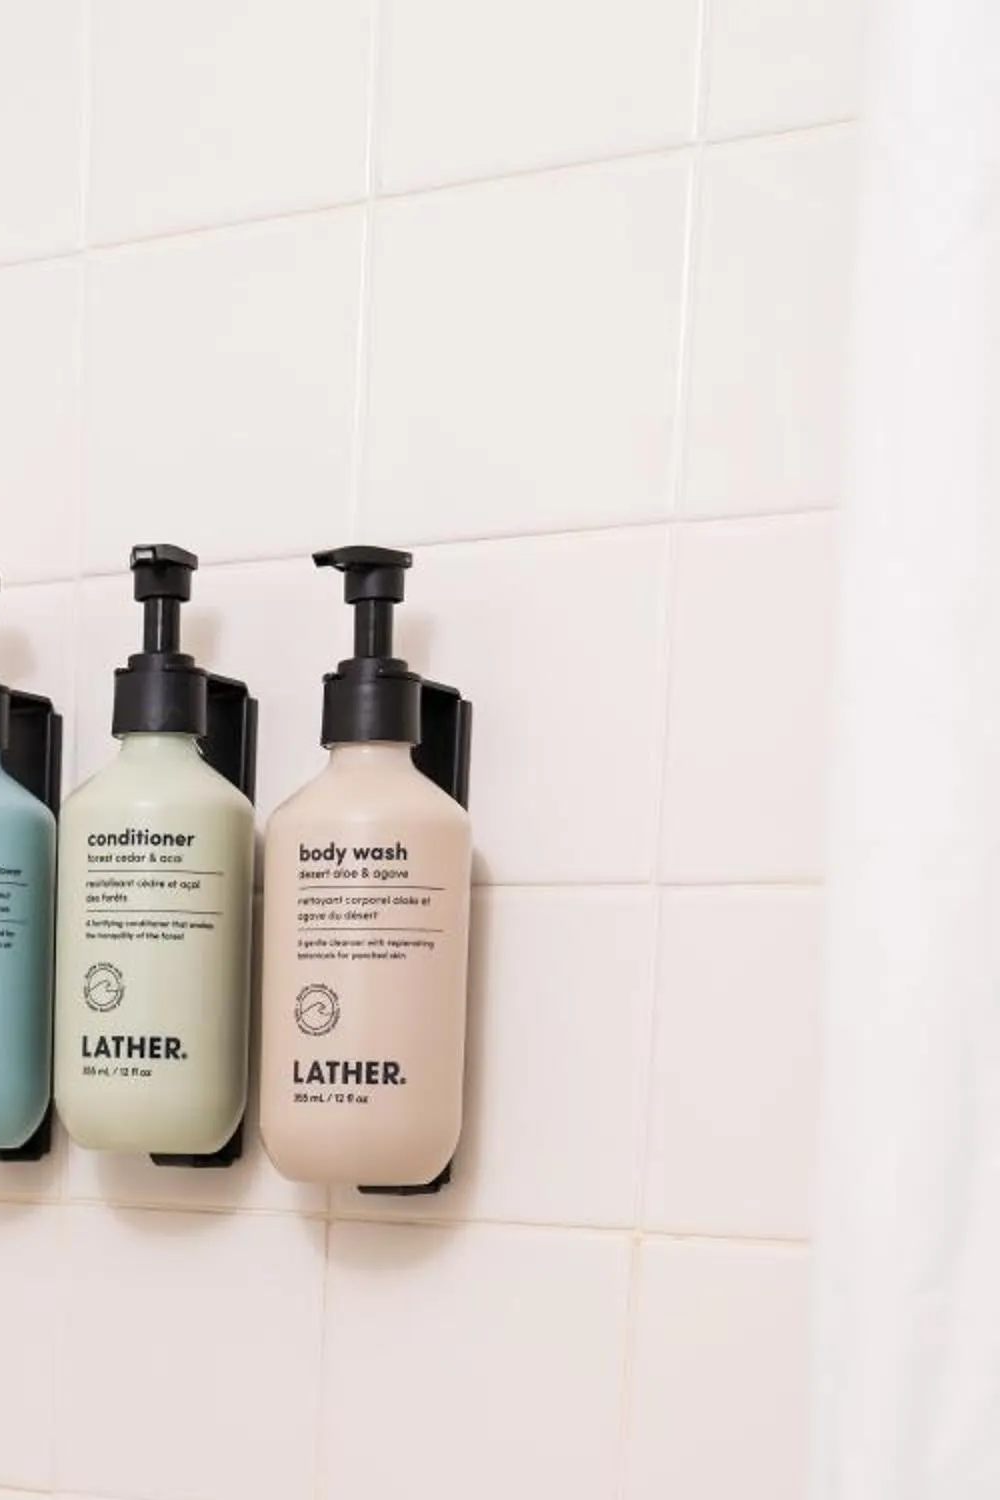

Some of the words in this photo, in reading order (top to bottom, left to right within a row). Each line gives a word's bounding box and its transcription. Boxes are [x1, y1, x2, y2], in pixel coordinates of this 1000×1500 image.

[87, 828, 196, 847] conditioner
[115, 852, 146, 864] cedar
[149, 852, 157, 864] &
[299, 841, 347, 866] body
[352, 841, 408, 861] wash
[333, 868, 359, 880] aloe
[361, 867, 370, 879] &
[373, 869, 409, 881] agave
[81, 1035, 188, 1060] LATHER.
[293, 1060, 407, 1085] LATHER.
[334, 1093, 344, 1103] 12
